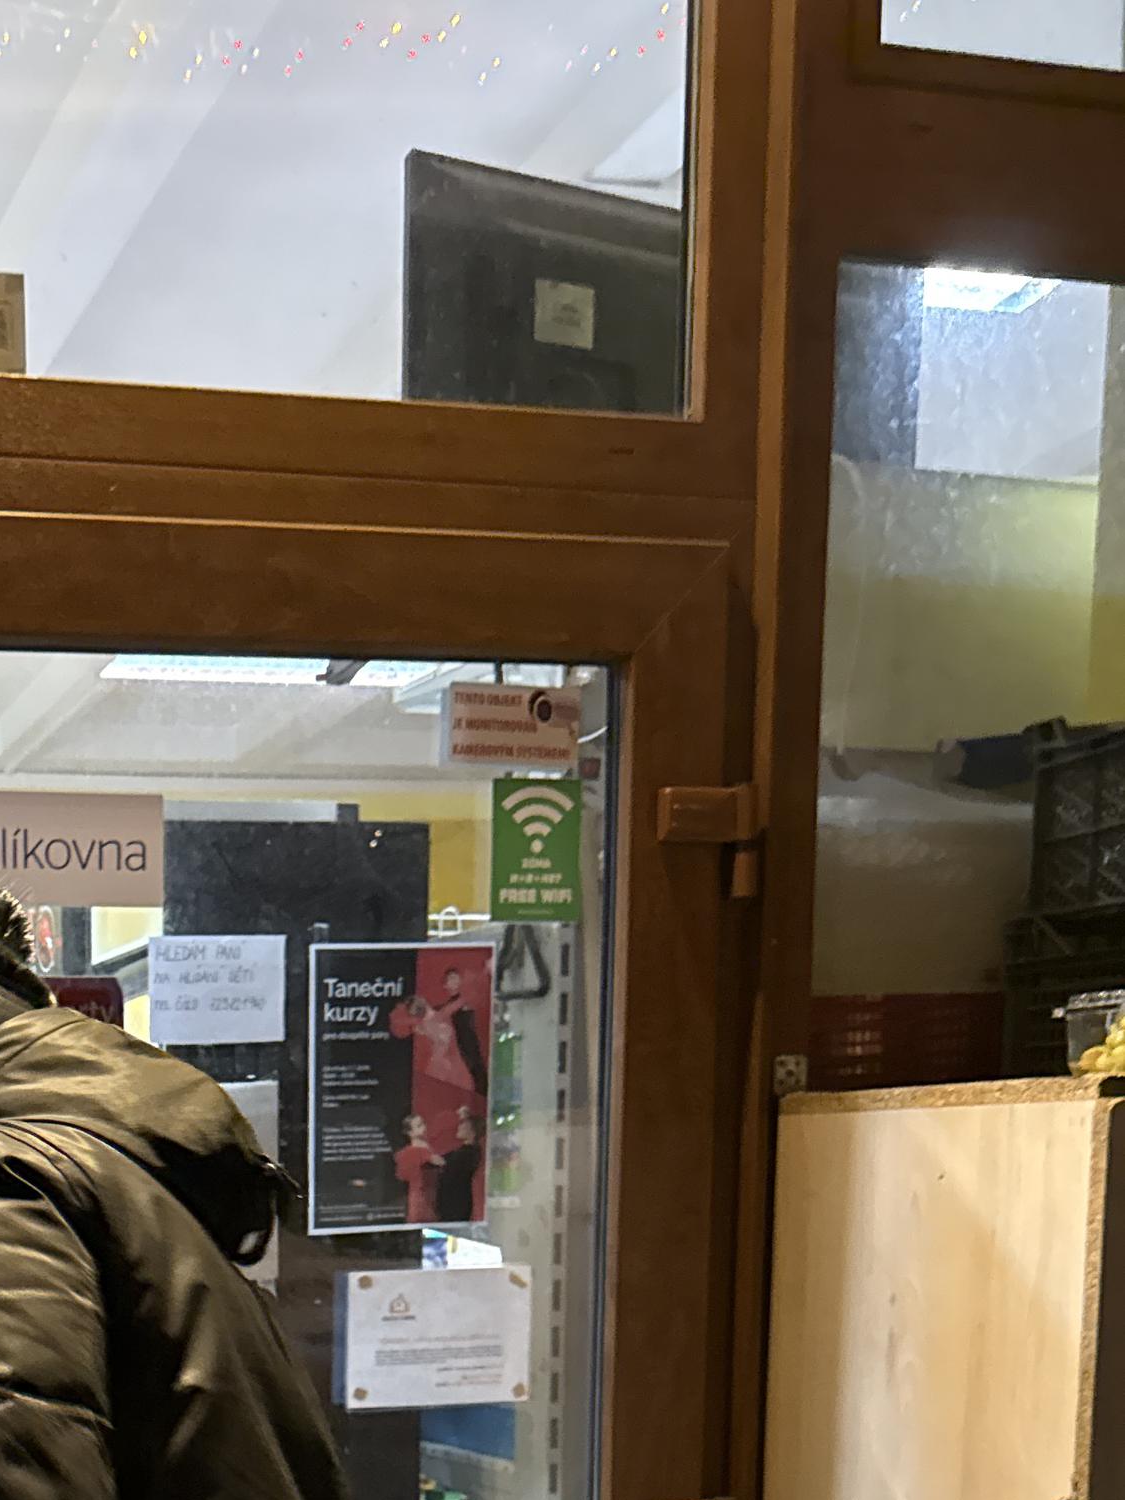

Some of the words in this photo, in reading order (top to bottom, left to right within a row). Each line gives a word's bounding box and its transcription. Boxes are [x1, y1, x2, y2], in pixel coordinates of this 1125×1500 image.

[454, 691, 485, 705] TENTO
[486, 693, 524, 707] OBJEKT
[452, 717, 463, 730] JE
[499, 888, 537, 904] FREE
[322, 976, 404, 999] Taneční
[323, 1002, 379, 1027] kurzy
